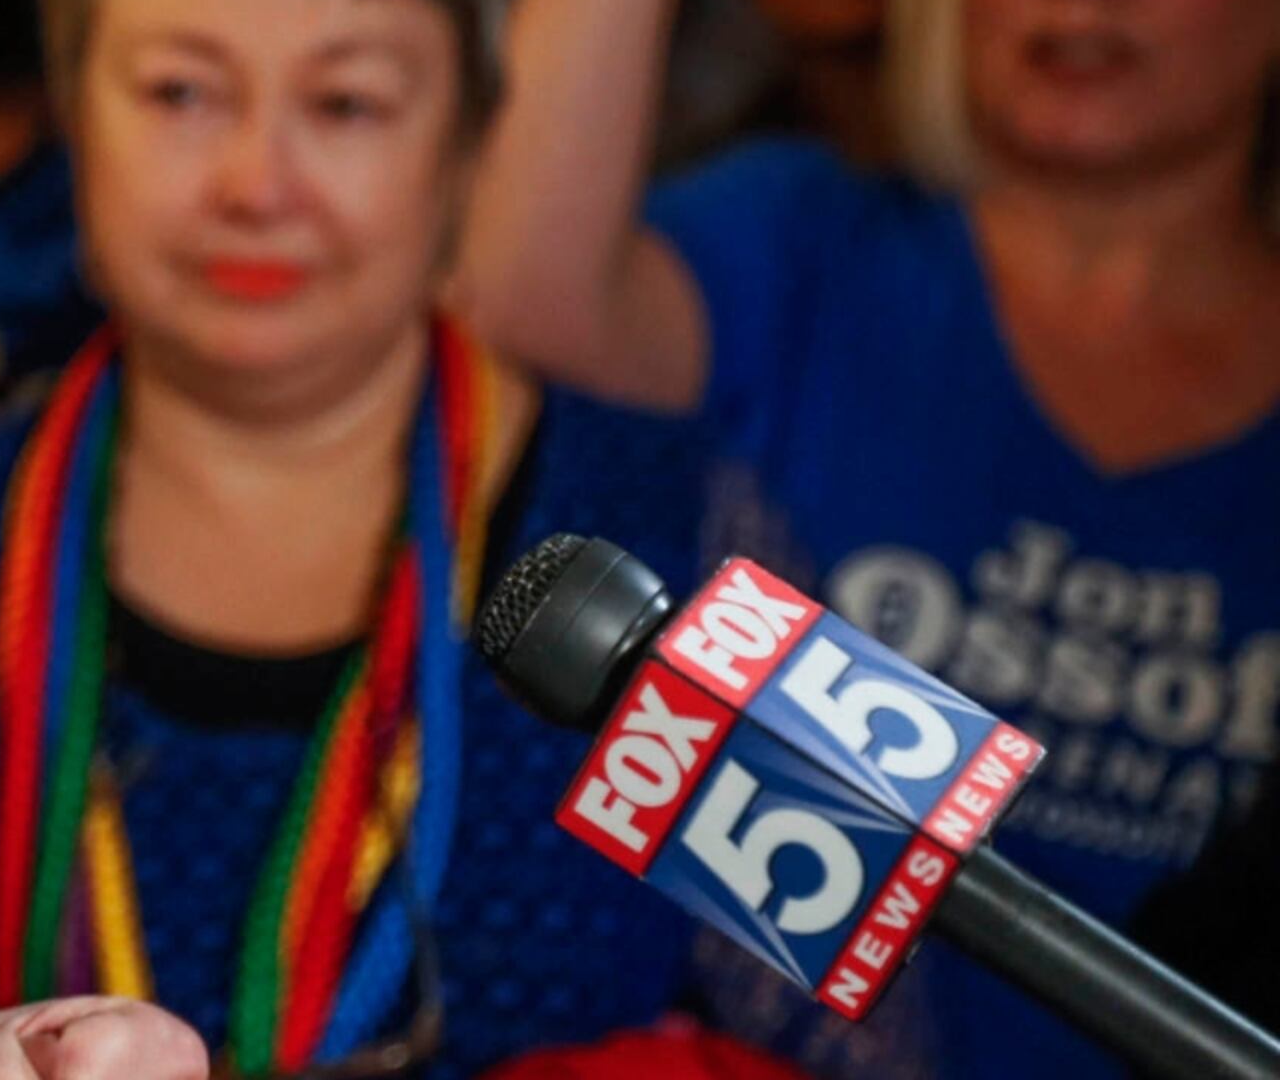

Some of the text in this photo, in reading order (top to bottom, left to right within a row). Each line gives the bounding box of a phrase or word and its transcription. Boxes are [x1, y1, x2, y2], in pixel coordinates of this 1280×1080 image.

[670, 570, 807, 692] FOX
[971, 518, 1221, 642] Jon
[572, 682, 719, 853] FOX
[780, 635, 960, 780] 5
[681, 760, 864, 935] 5
[930, 730, 1032, 844] NEWS
[828, 849, 947, 1010] NEWS
